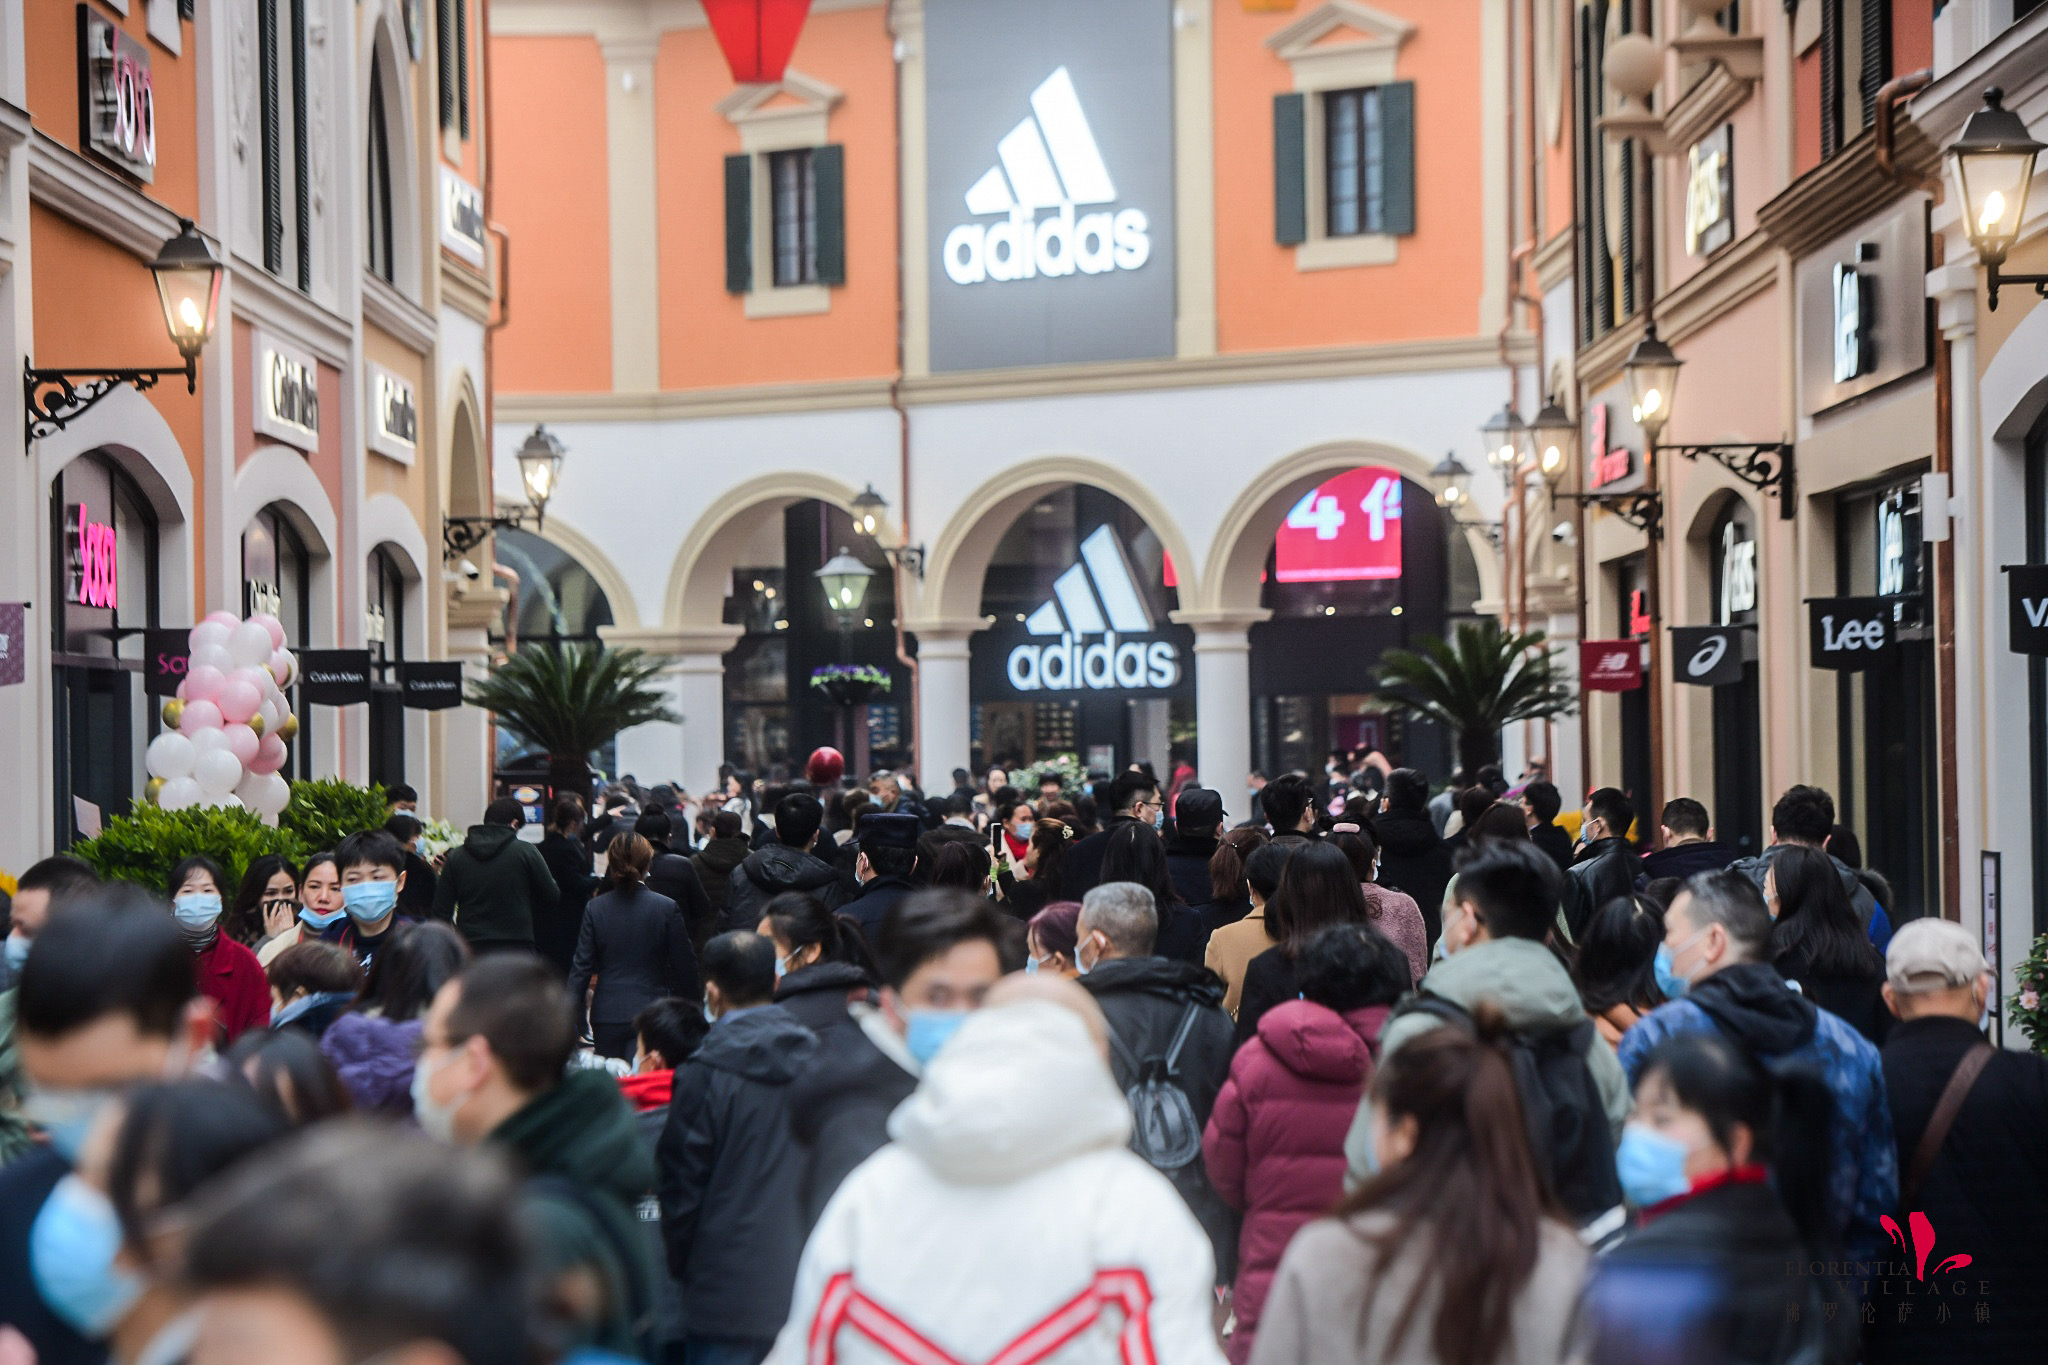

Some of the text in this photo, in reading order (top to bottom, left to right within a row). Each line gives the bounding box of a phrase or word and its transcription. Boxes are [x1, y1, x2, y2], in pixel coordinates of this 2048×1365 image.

[943, 200, 1151, 285] adidas
[1007, 630, 1177, 691] adidas
[1821, 614, 1885, 651] Lee
